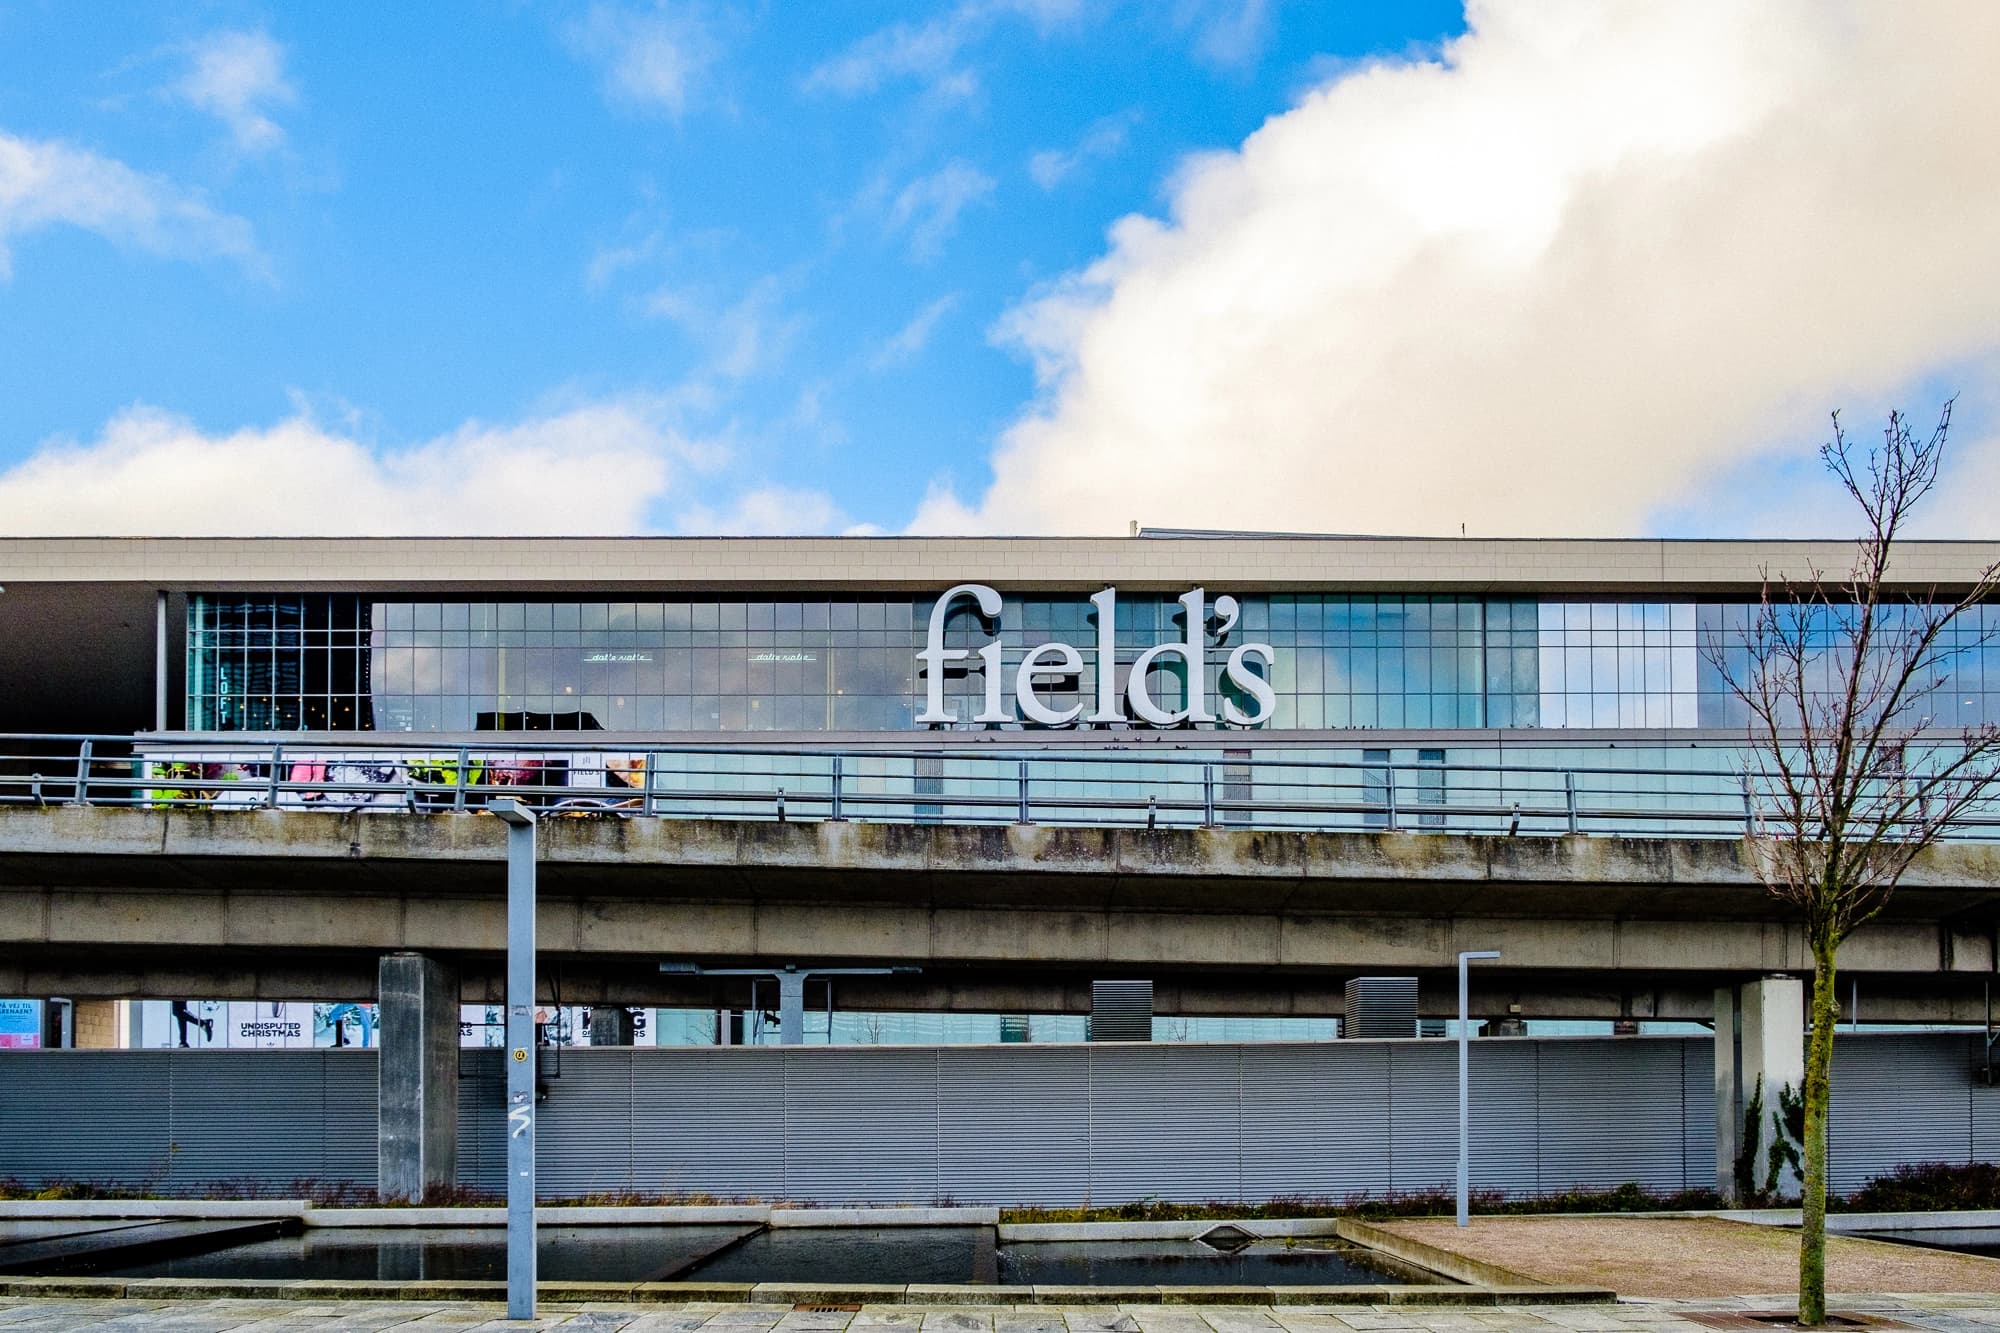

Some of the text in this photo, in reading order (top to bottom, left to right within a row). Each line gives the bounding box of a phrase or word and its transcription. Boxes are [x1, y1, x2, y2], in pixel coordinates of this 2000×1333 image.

[916, 584, 1276, 725] field's
[220, 667, 228, 724] LOFT
[240, 1022, 301, 1030] UNDISPUTED
